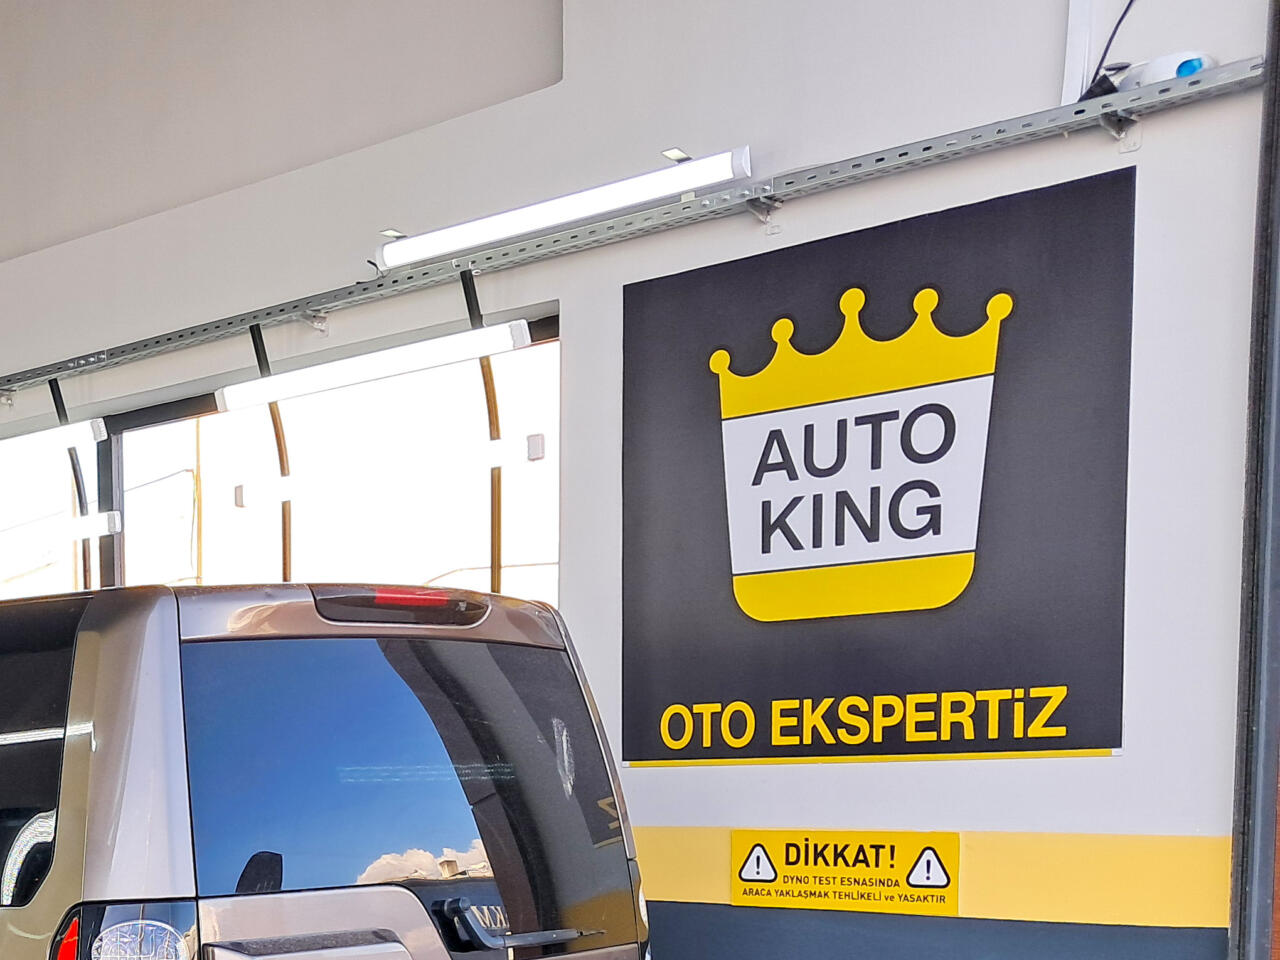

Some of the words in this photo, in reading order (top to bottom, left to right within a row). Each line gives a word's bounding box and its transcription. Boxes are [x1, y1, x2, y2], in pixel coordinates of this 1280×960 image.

[751, 403, 956, 487] AUTO
[761, 479, 941, 554] KING
[659, 701, 755, 749] OTO
[784, 838, 896, 868] DİKKAT!
[742, 888, 772, 897] ARACA
[774, 889, 830, 900] YAKLAŞMAK
[884, 894, 895, 902] ve
[897, 893, 946, 904] YASAKTIR
[783, 875, 810, 886] DYNO
[812, 876, 837, 886] TEST
[840, 877, 900, 888] ESNASINDA
